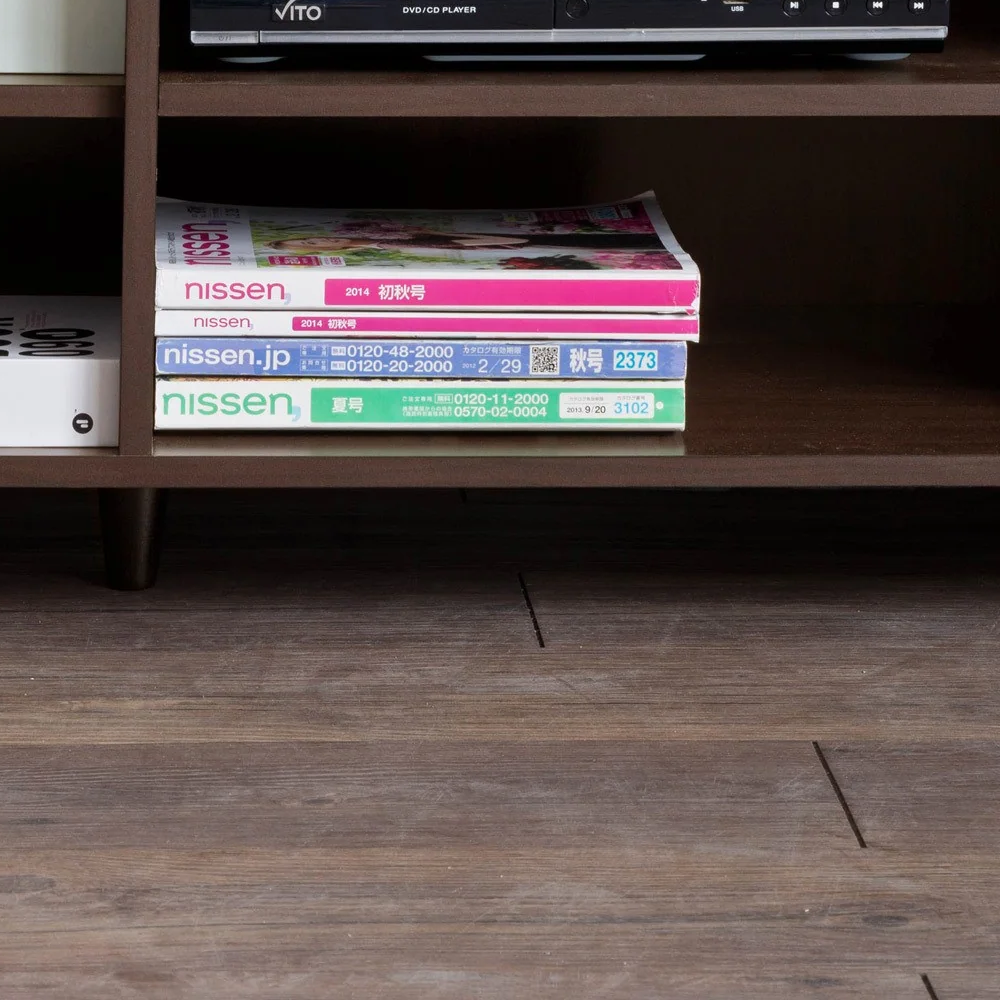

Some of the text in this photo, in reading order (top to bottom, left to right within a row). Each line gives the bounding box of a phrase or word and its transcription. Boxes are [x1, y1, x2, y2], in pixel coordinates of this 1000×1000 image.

[442, 6, 477, 14] PLAYER
[345, 287, 370, 297] 2014
[378, 284, 426, 301] 初秋号
[301, 319, 323, 328] 2014
[328, 318, 357, 330] 初秋号
[164, 343, 291, 371] nissen.jp
[347, 345, 454, 359] 0120-48-2000
[347, 359, 453, 373] 0120-20-2000
[569, 348, 604, 373] 秋号
[615, 351, 656, 369] 2373
[331, 397, 364, 414] 夏号
[453, 393, 549, 405] 0120-11-2000
[453, 406, 548, 418] 0570-02-0004
[614, 402, 649, 415] 3102
